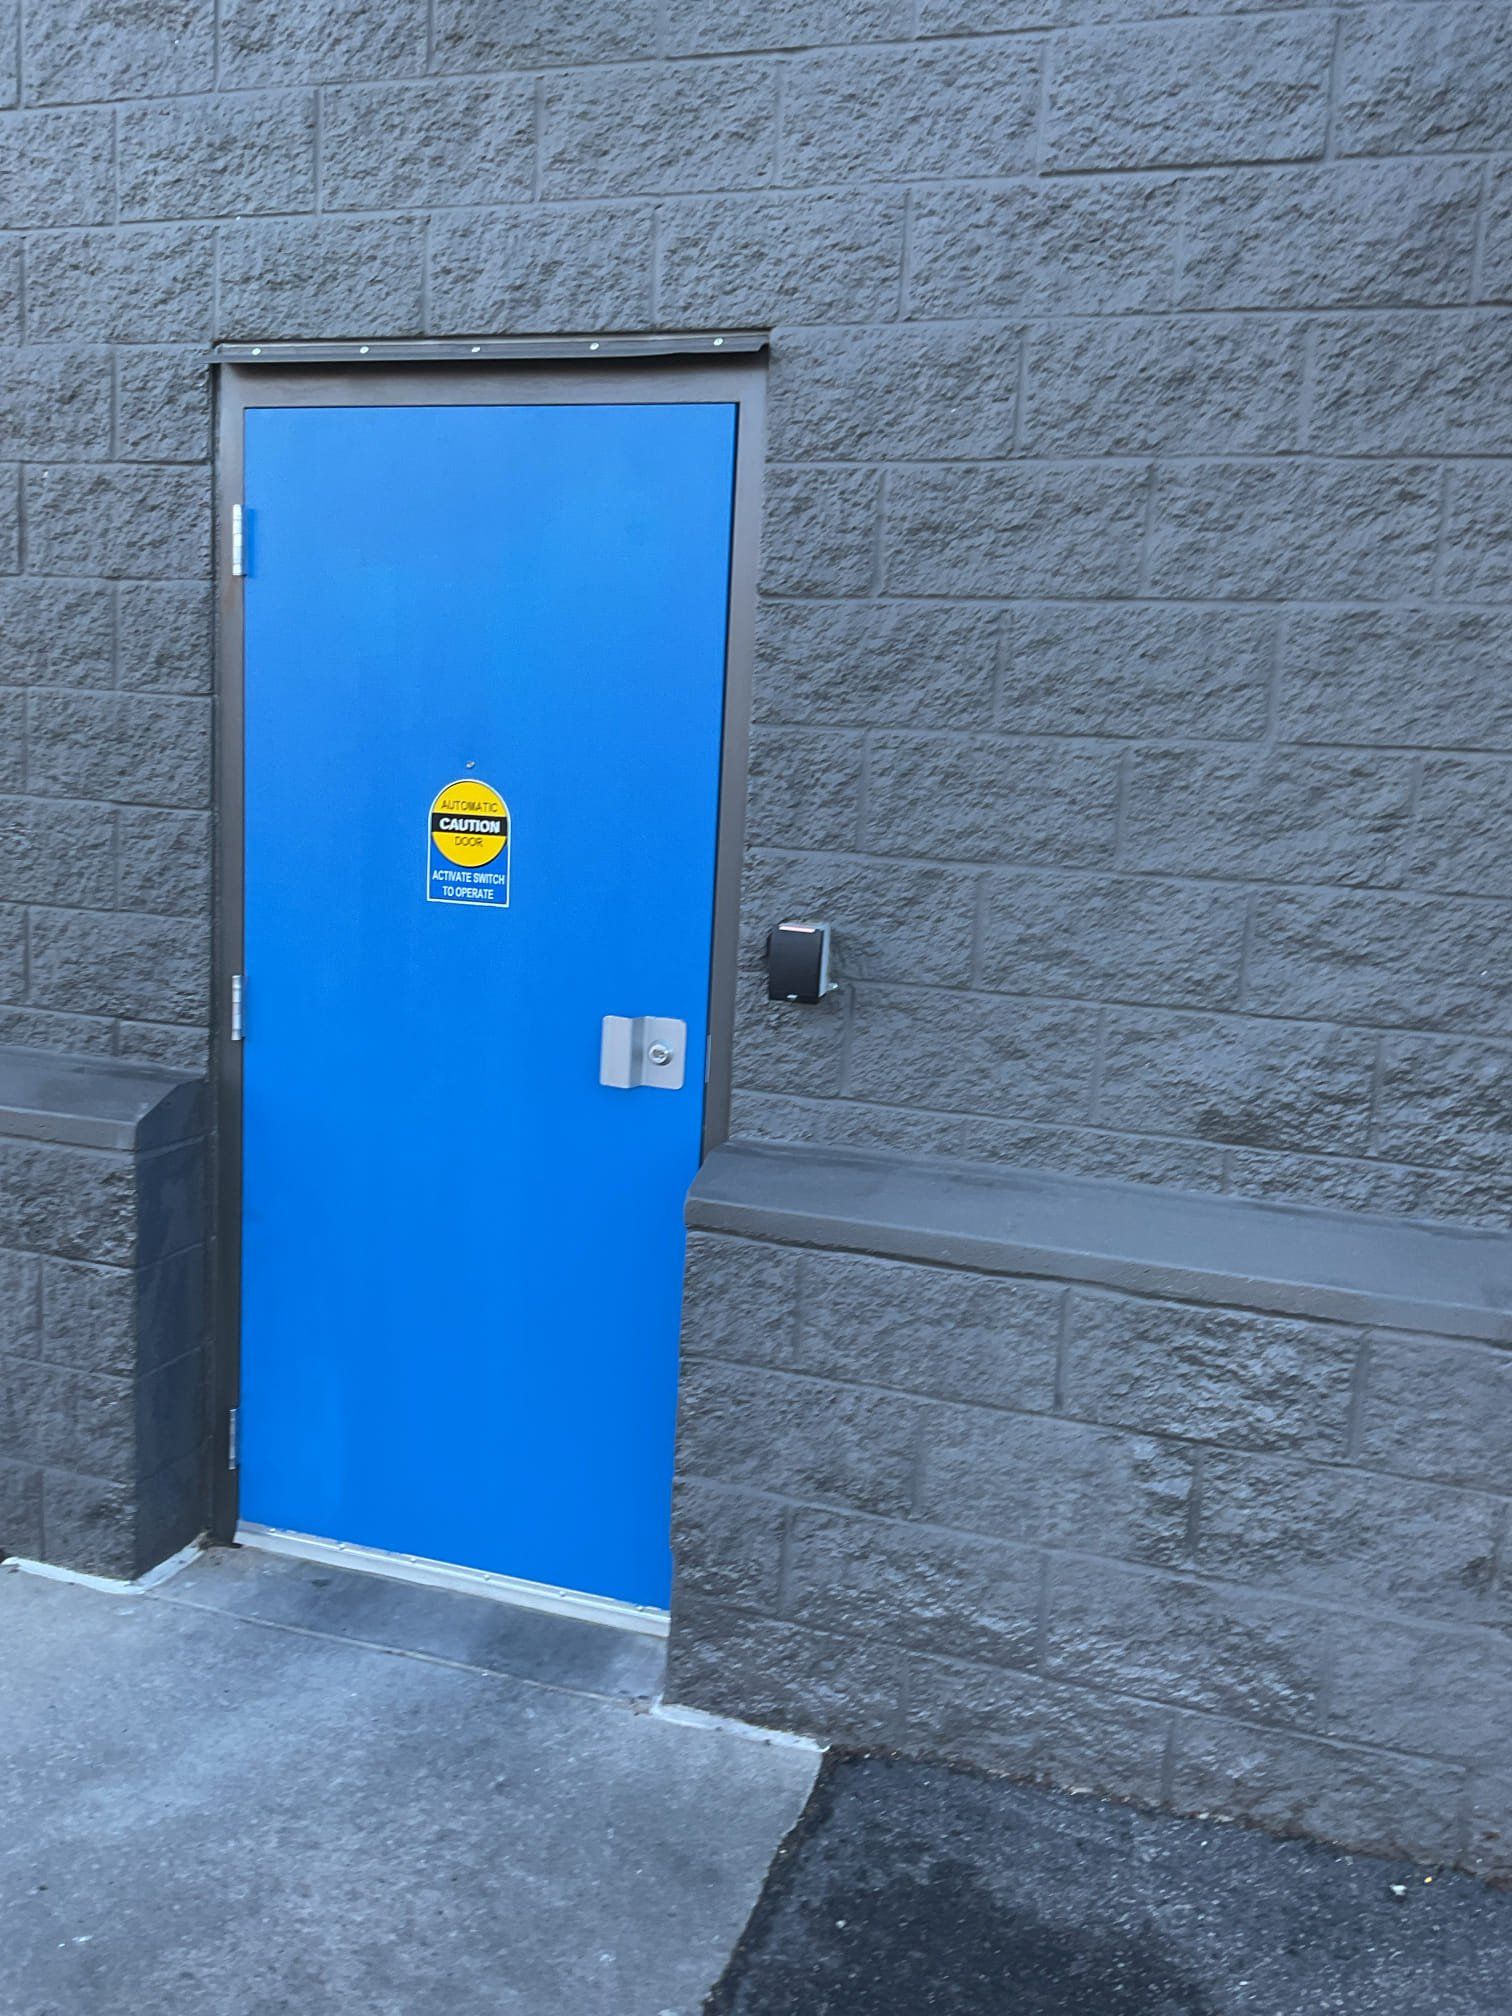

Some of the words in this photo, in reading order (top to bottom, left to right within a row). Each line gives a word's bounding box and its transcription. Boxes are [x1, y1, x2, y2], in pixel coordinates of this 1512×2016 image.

[441, 800, 498, 813] AUTOMATIC
[439, 817, 500, 834] CAUTION
[454, 836, 483, 847] DOOR
[432, 870, 472, 883] ACTIVATE
[473, 872, 505, 885] SWITCH
[442, 886, 454, 897] TO
[455, 887, 494, 900] OPERATE
